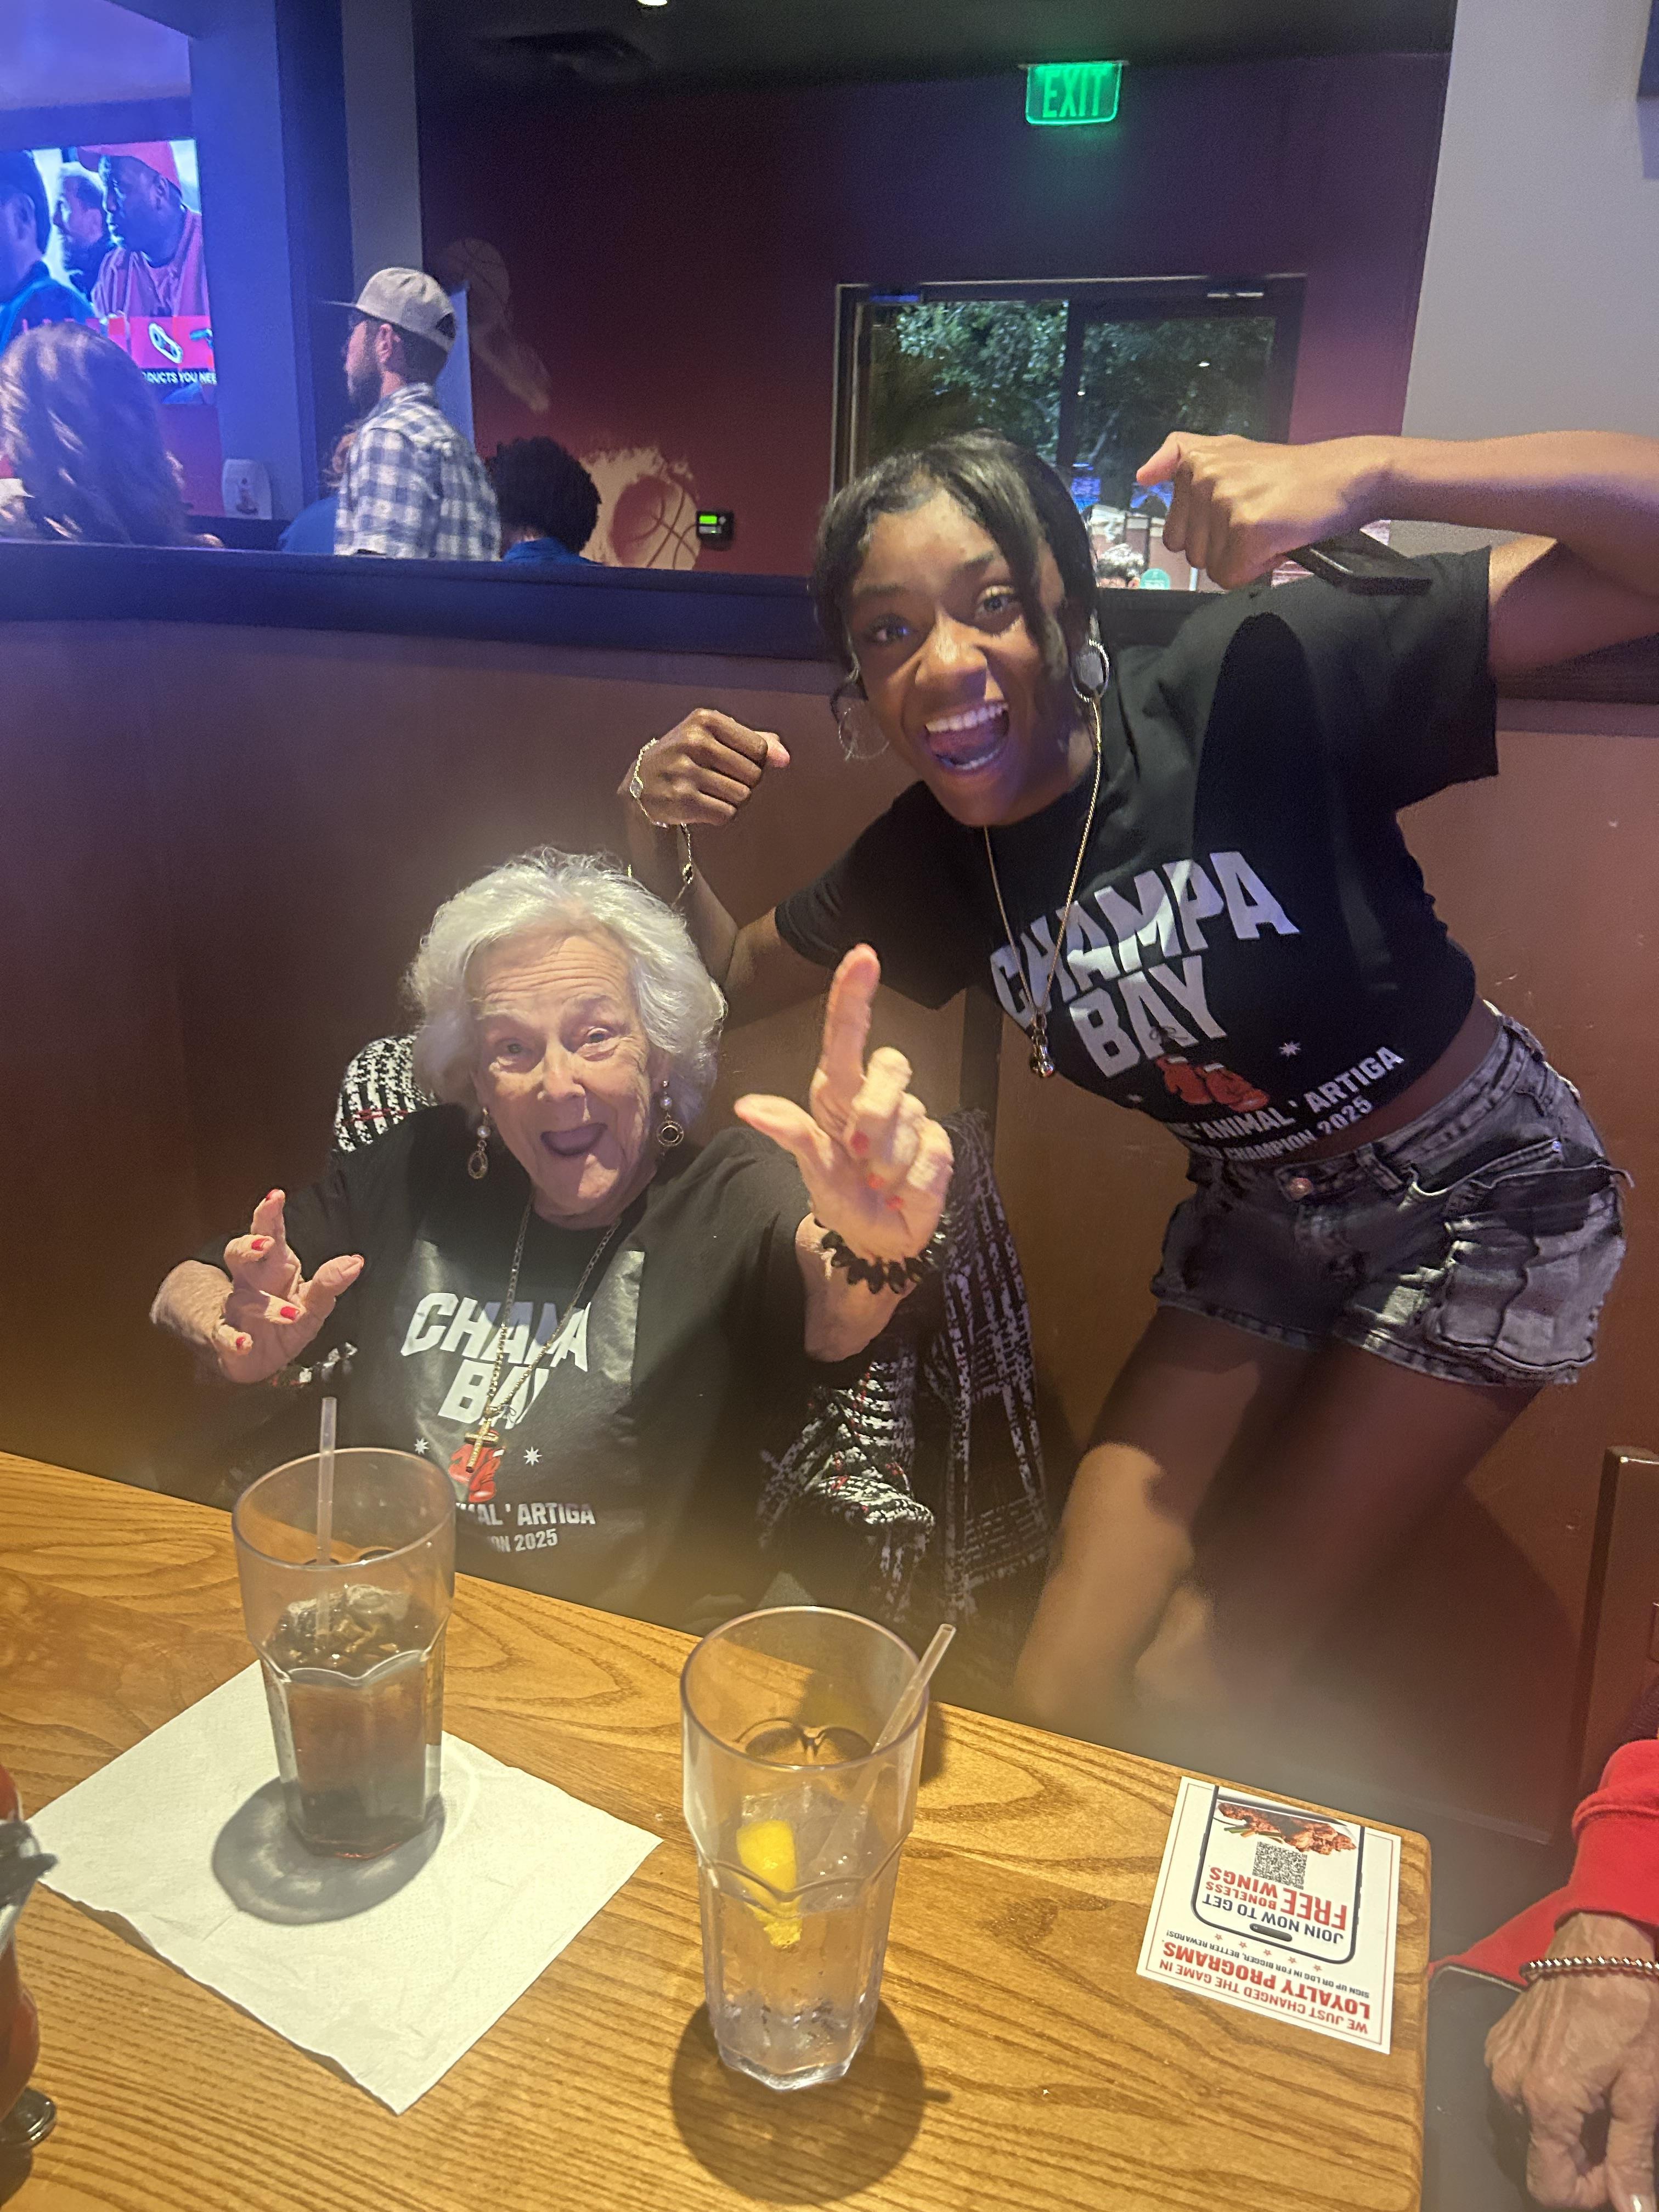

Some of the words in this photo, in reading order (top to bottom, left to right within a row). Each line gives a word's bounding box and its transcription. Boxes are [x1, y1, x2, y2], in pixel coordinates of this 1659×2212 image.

[1042, 66, 1109, 117] EXIT
[178, 371, 198, 383] YOU
[990, 851, 1300, 1029] CHAMPA
[1069, 955, 1227, 1077] BAY
[1304, 1046, 1404, 1113] ARTIGA
[1317, 1096, 1373, 1135] 2025
[517, 1502, 596, 1526] ARTIGA
[514, 1528, 558, 1553] 2025
[1202, 1894, 1233, 1911] GET
[1205, 1881, 1277, 1911] BONELESS
[1237, 1904, 1257, 1920] TO
[1280, 1887, 1347, 1931] FREE
[1261, 1911, 1300, 1933] NOW
[1166, 1930, 1207, 1948] REWARDS!
[1304, 1923, 1344, 1944] JOIN
[1209, 1942, 1239, 1959] BETTER
[1159, 1959, 1173, 1972] IN
[1242, 1953, 1274, 1969] BIGGER,
[1276, 1963, 1292, 1974] FOR
[1175, 1964, 1212, 1984] GAME
[1305, 1973, 1321, 1984] LOG
[1322, 1978, 1334, 1987] OR
[1215, 1976, 1240, 1994] THE
[1335, 1983, 1347, 1992] UP
[1349, 1987, 1370, 1998] SIGN
[1244, 1987, 1306, 2015] CHANGED
[1280, 1979, 1370, 2019] LOYALTY
[1308, 2007, 1344, 2025] JUST
[1347, 2019, 1368, 2034] WE
